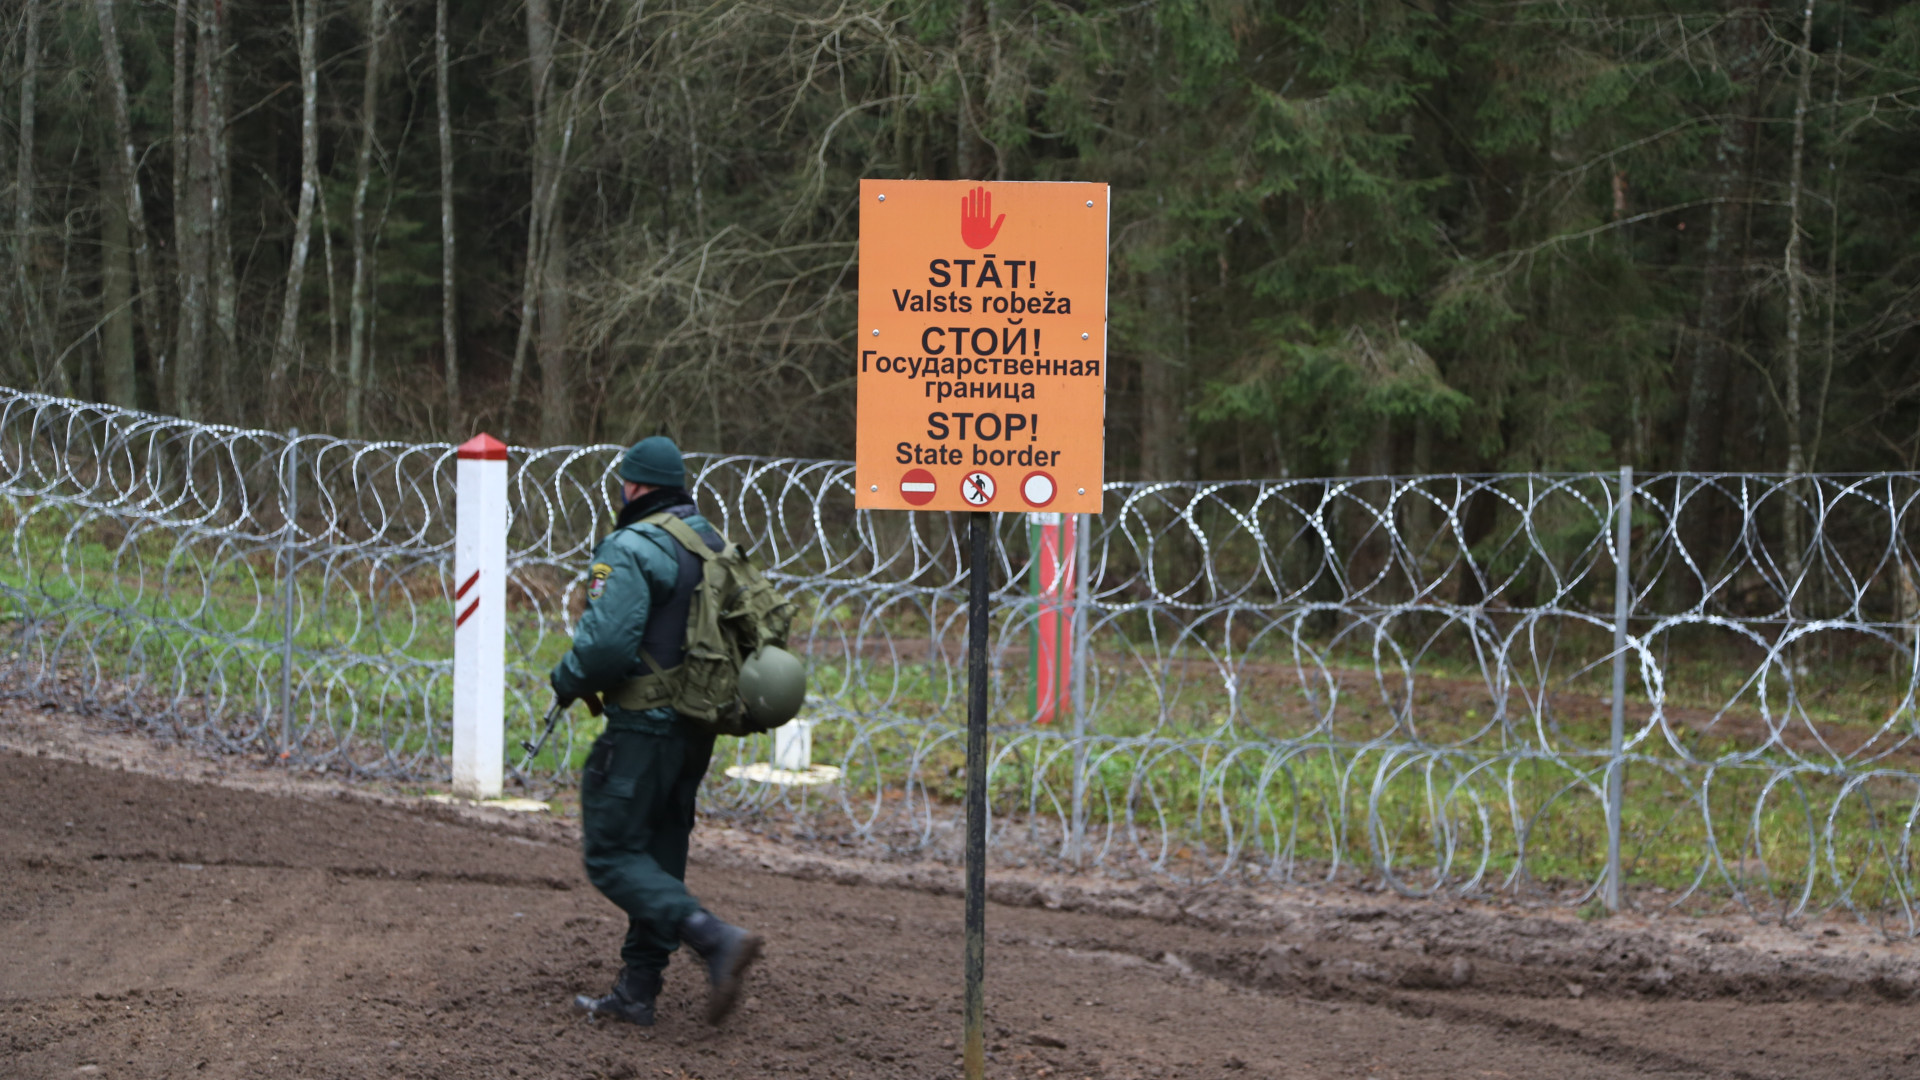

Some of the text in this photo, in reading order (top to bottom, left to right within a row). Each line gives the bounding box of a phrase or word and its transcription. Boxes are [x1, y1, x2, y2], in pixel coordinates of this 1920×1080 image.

[929, 254, 1036, 288] STĀT!
[892, 289, 1071, 314] Valsts robeža
[922, 318, 1040, 356] СТОЙ!
[862, 351, 1100, 379] Государственная
[925, 381, 1035, 403] граница
[927, 412, 1037, 441] STOP!
[896, 442, 1061, 467] State border
